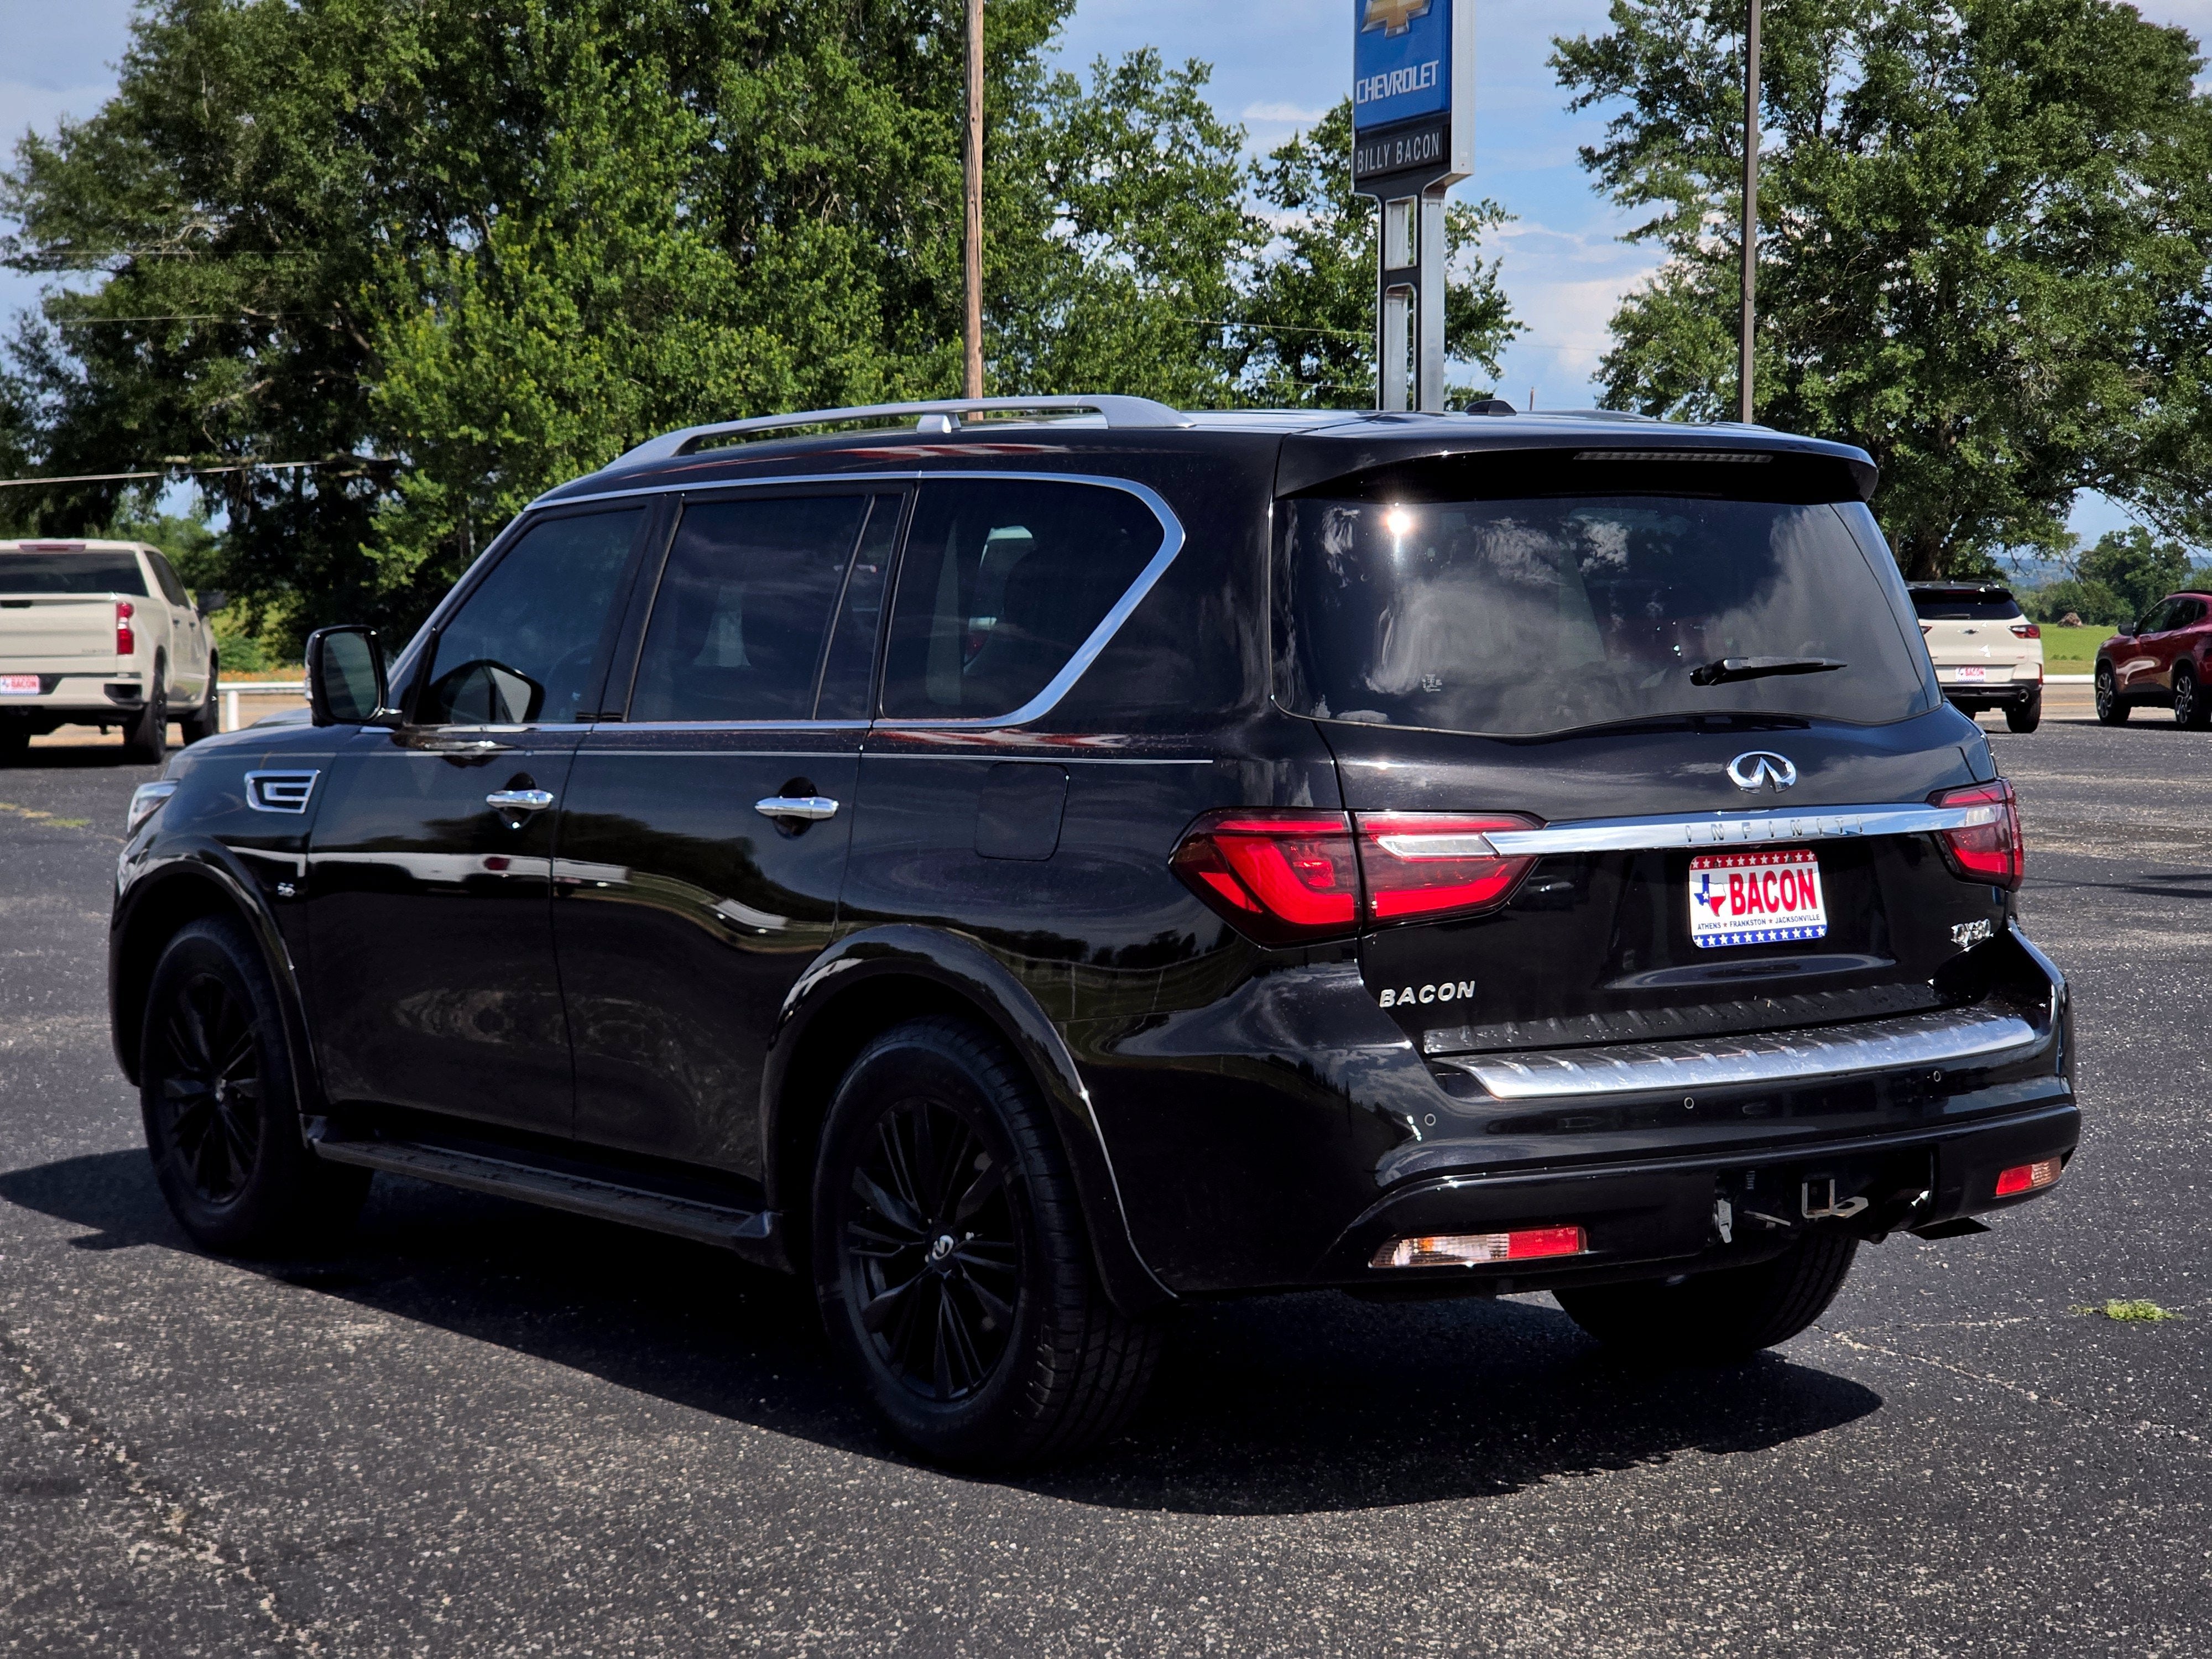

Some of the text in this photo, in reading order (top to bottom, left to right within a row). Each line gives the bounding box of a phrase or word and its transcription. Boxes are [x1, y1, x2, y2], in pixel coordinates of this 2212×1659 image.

[1357, 60, 1439, 105] CHEVROLET
[1357, 132, 1439, 174] BILLY BACON
[11, 678, 36, 688] BACON
[1965, 666, 1984, 676] BACON
[1686, 815, 1864, 843] INFINITI
[1729, 868, 1818, 916] BACON
[1698, 914, 1820, 930] ATHENS FRANKSTON JACKSONVILLE
[1379, 980, 1475, 1008] BACON
